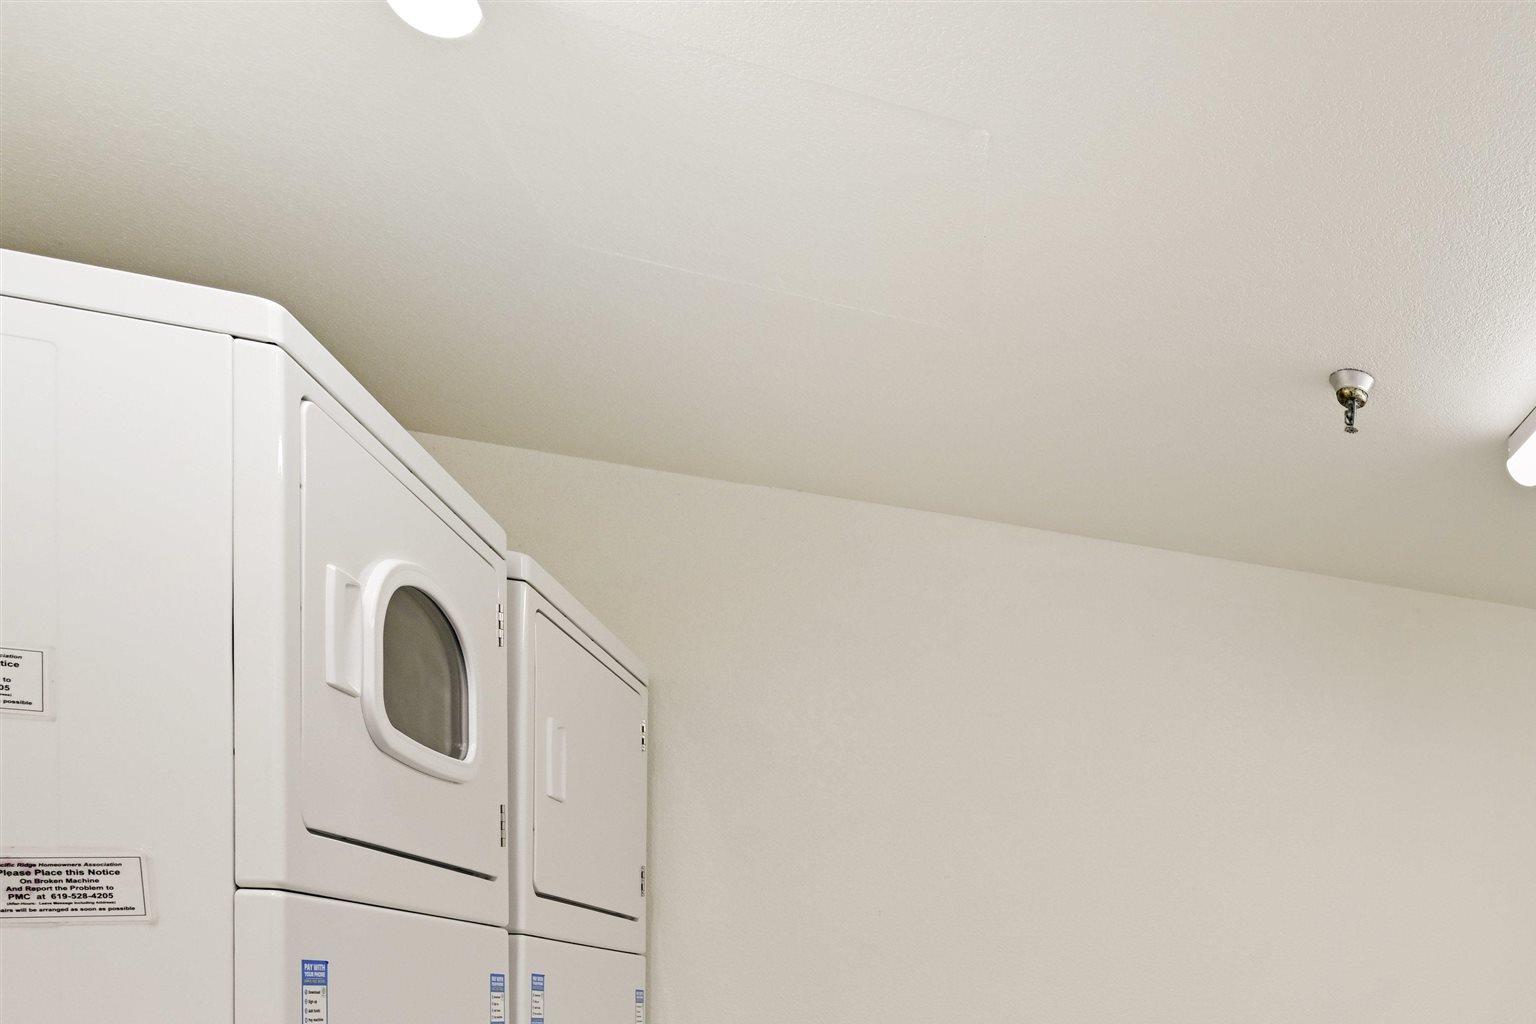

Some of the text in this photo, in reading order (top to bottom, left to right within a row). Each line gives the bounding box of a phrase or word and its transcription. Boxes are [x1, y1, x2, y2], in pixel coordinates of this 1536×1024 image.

[65, 868, 85, 876] this
[87, 868, 121, 876] Notice
[51, 892, 114, 900] 619-528-4205
